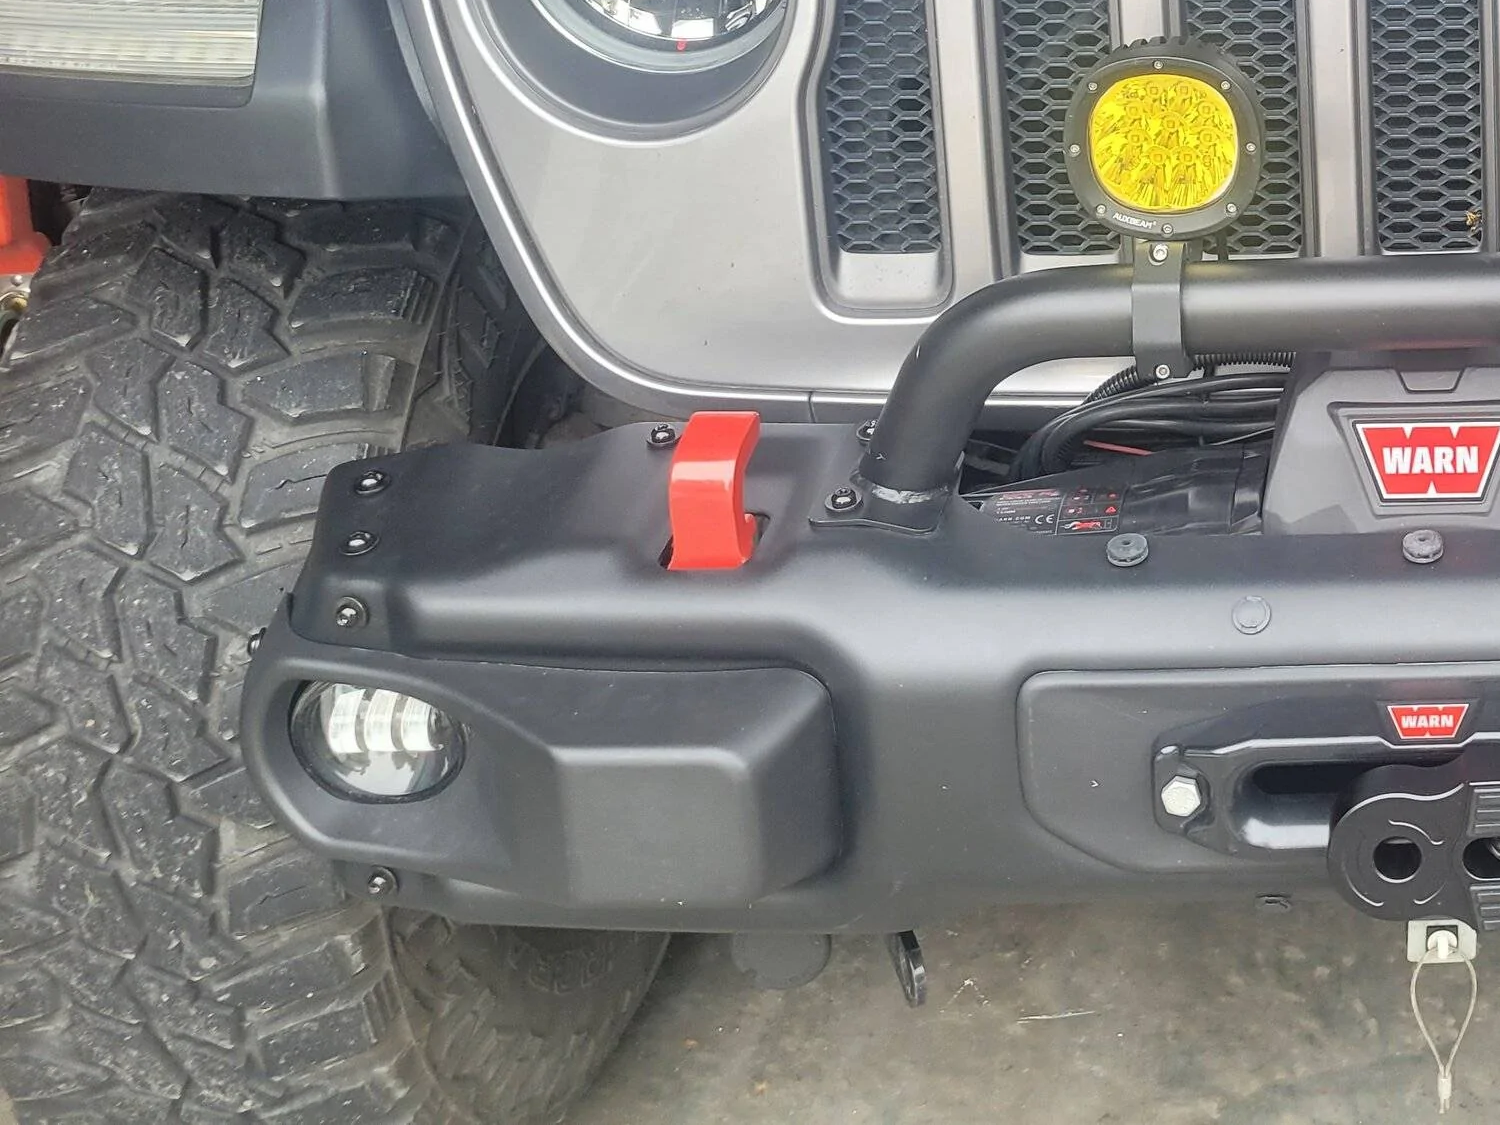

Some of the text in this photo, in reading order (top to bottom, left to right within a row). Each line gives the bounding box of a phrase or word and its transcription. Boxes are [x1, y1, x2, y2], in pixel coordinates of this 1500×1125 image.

[1112, 212, 1154, 230] AUXBEAM
[1381, 443, 1480, 475] WARN
[1400, 713, 1455, 731] WARN
